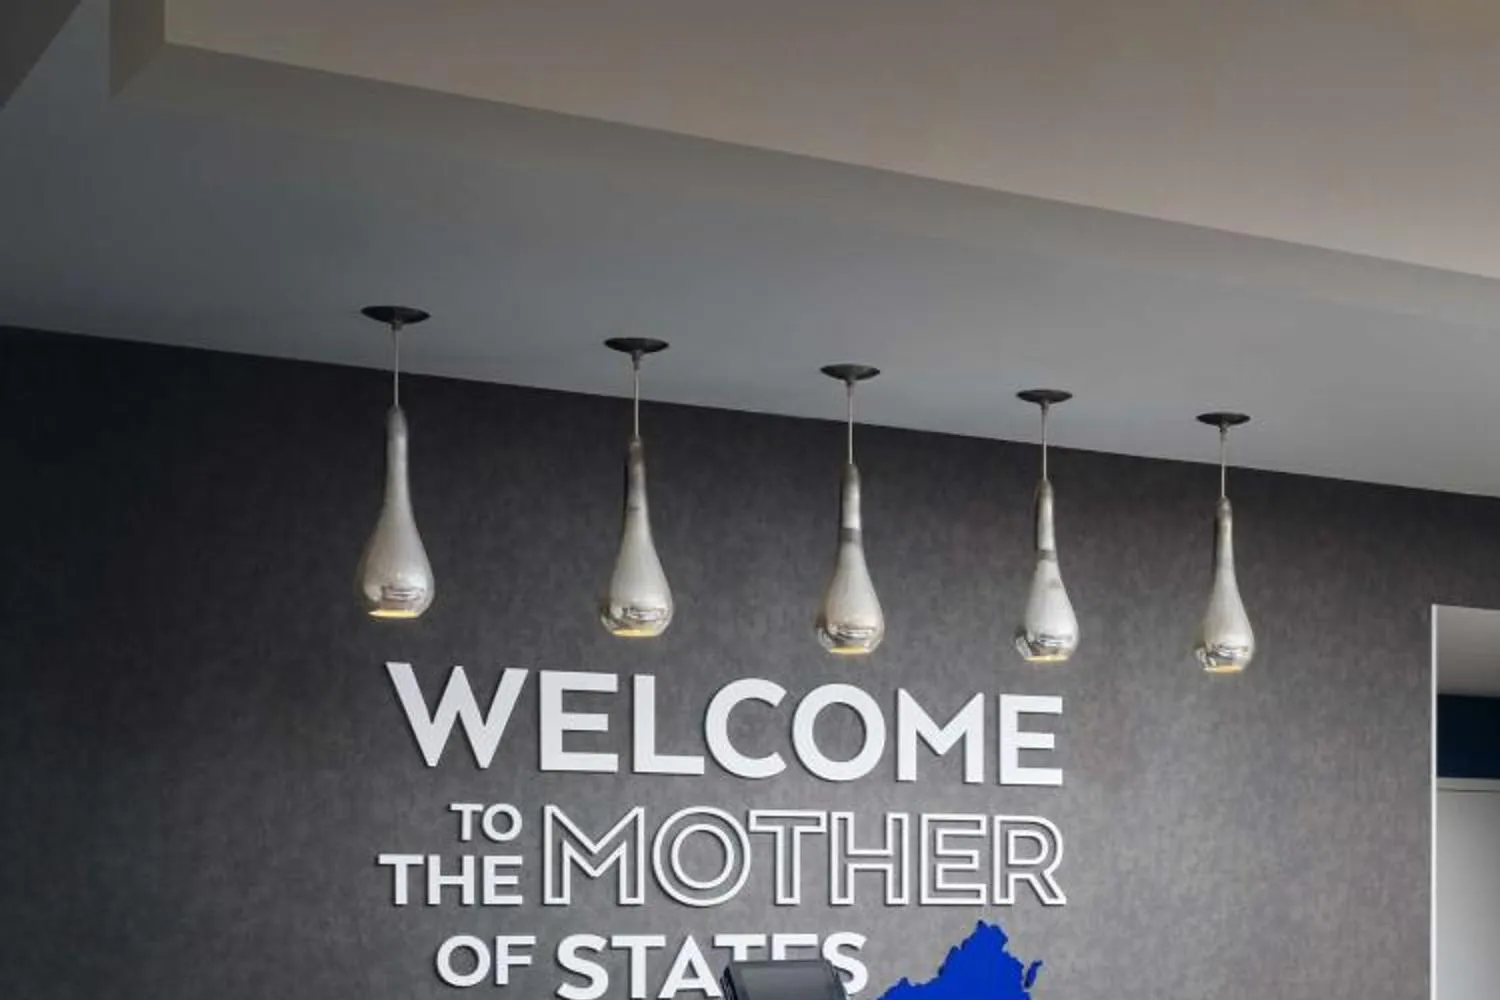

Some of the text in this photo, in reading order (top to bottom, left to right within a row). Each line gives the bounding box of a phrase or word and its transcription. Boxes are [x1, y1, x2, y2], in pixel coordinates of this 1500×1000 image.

[386, 661, 1065, 787] WELCOME
[378, 804, 1069, 907] THE MOTHER
[450, 802, 524, 842] TO
[436, 934, 538, 988] OF
